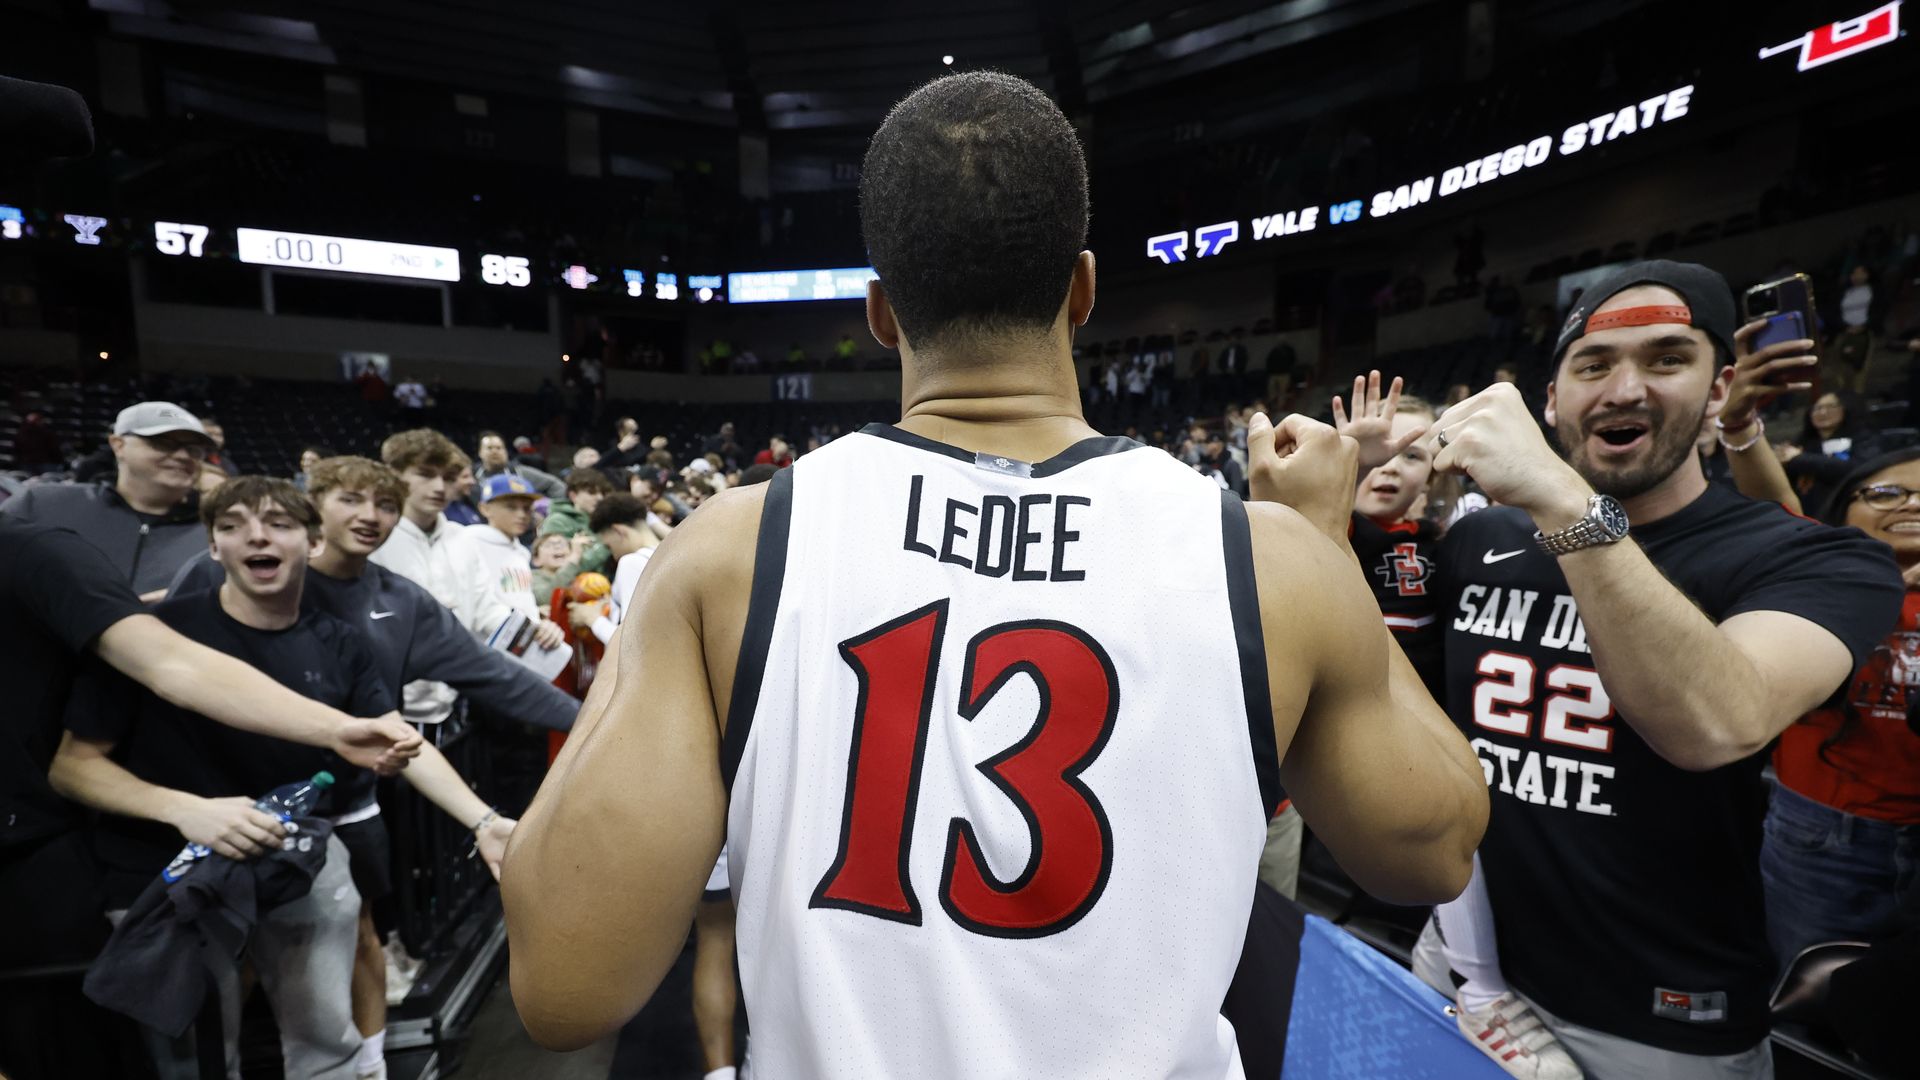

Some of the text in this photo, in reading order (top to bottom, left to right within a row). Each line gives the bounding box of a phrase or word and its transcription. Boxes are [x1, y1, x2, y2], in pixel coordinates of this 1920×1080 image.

[1252, 84, 1695, 241] YALE VS SAN DIEGO STATE
[154, 221, 209, 257] 57
[481, 253, 531, 287] 85
[776, 376, 811, 400] 121
[1453, 584, 1540, 642] SAN
[1472, 649, 1616, 754] 22
[808, 597, 1120, 940] 13
[1470, 737, 1615, 816] STATE
